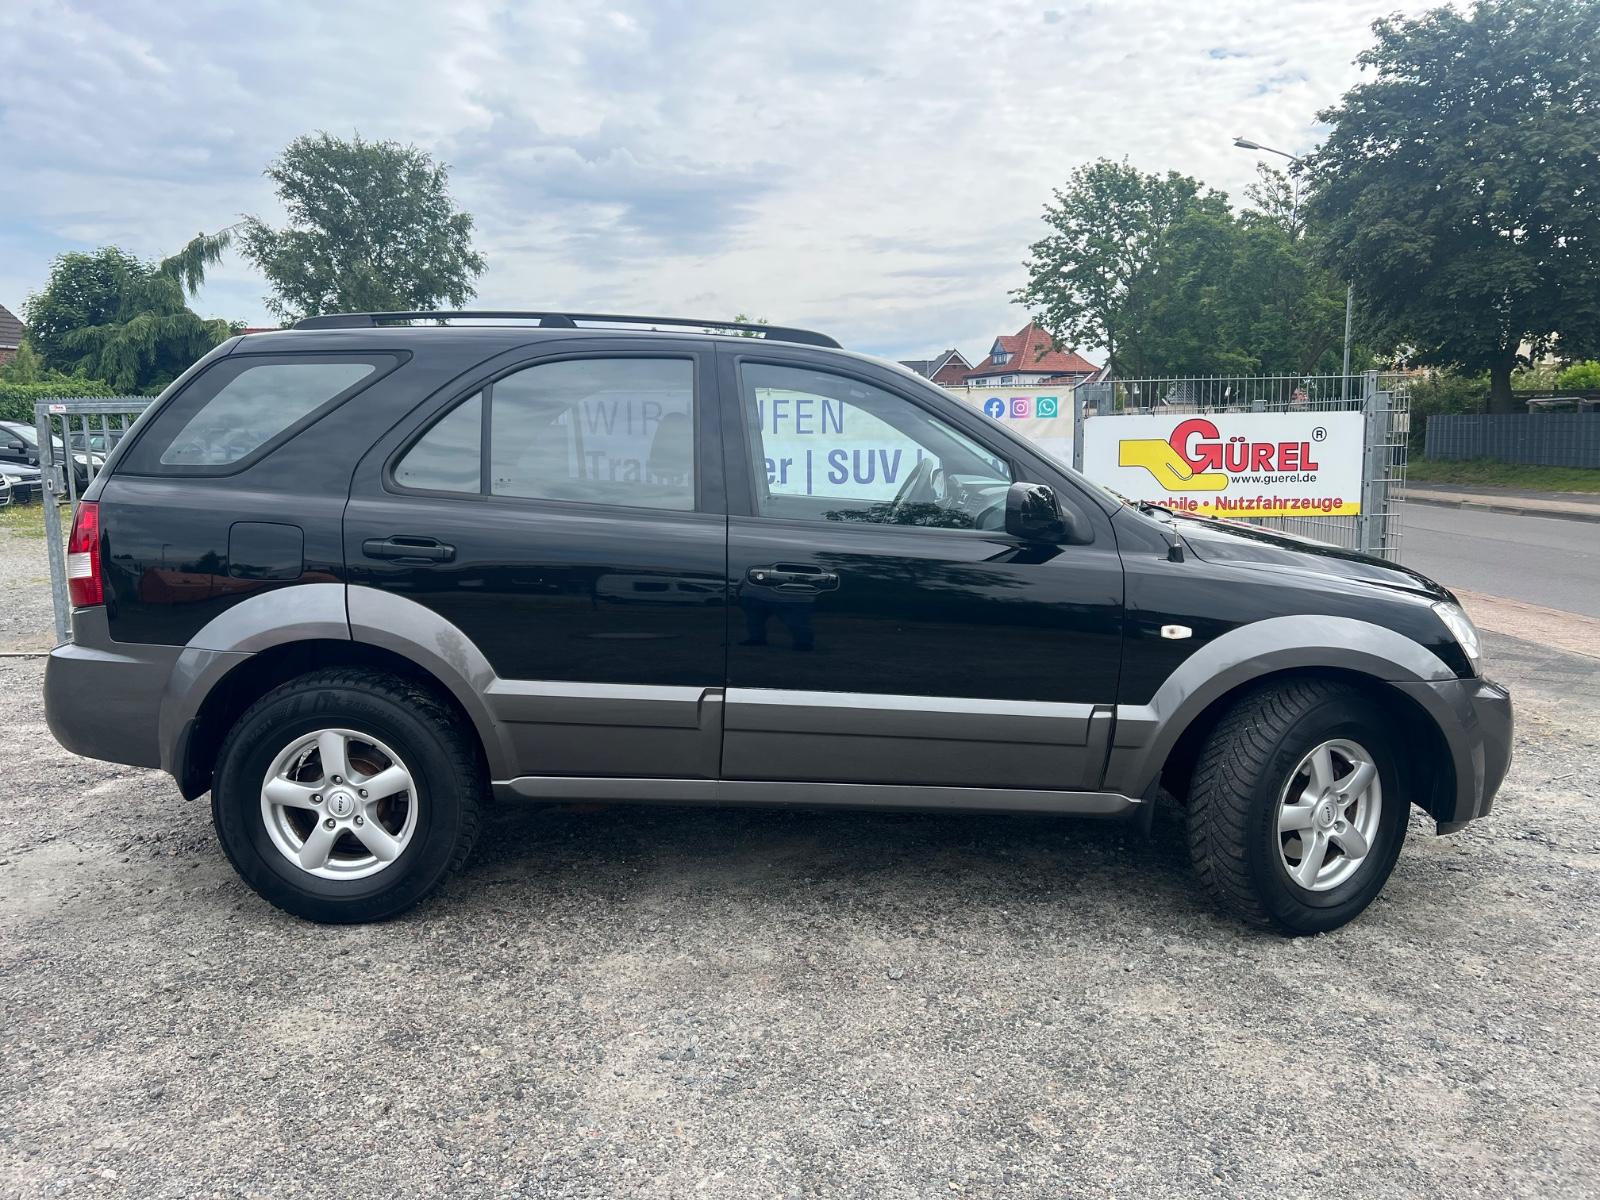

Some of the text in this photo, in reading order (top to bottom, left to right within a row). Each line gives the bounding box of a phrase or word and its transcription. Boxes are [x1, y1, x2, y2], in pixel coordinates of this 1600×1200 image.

[1170, 418, 1319, 474] GÜREL
[827, 449, 903, 485] SUV
[1231, 474, 1317, 485] www.guerel.de
[1215, 495, 1343, 513] Nutzfahrzeuge
